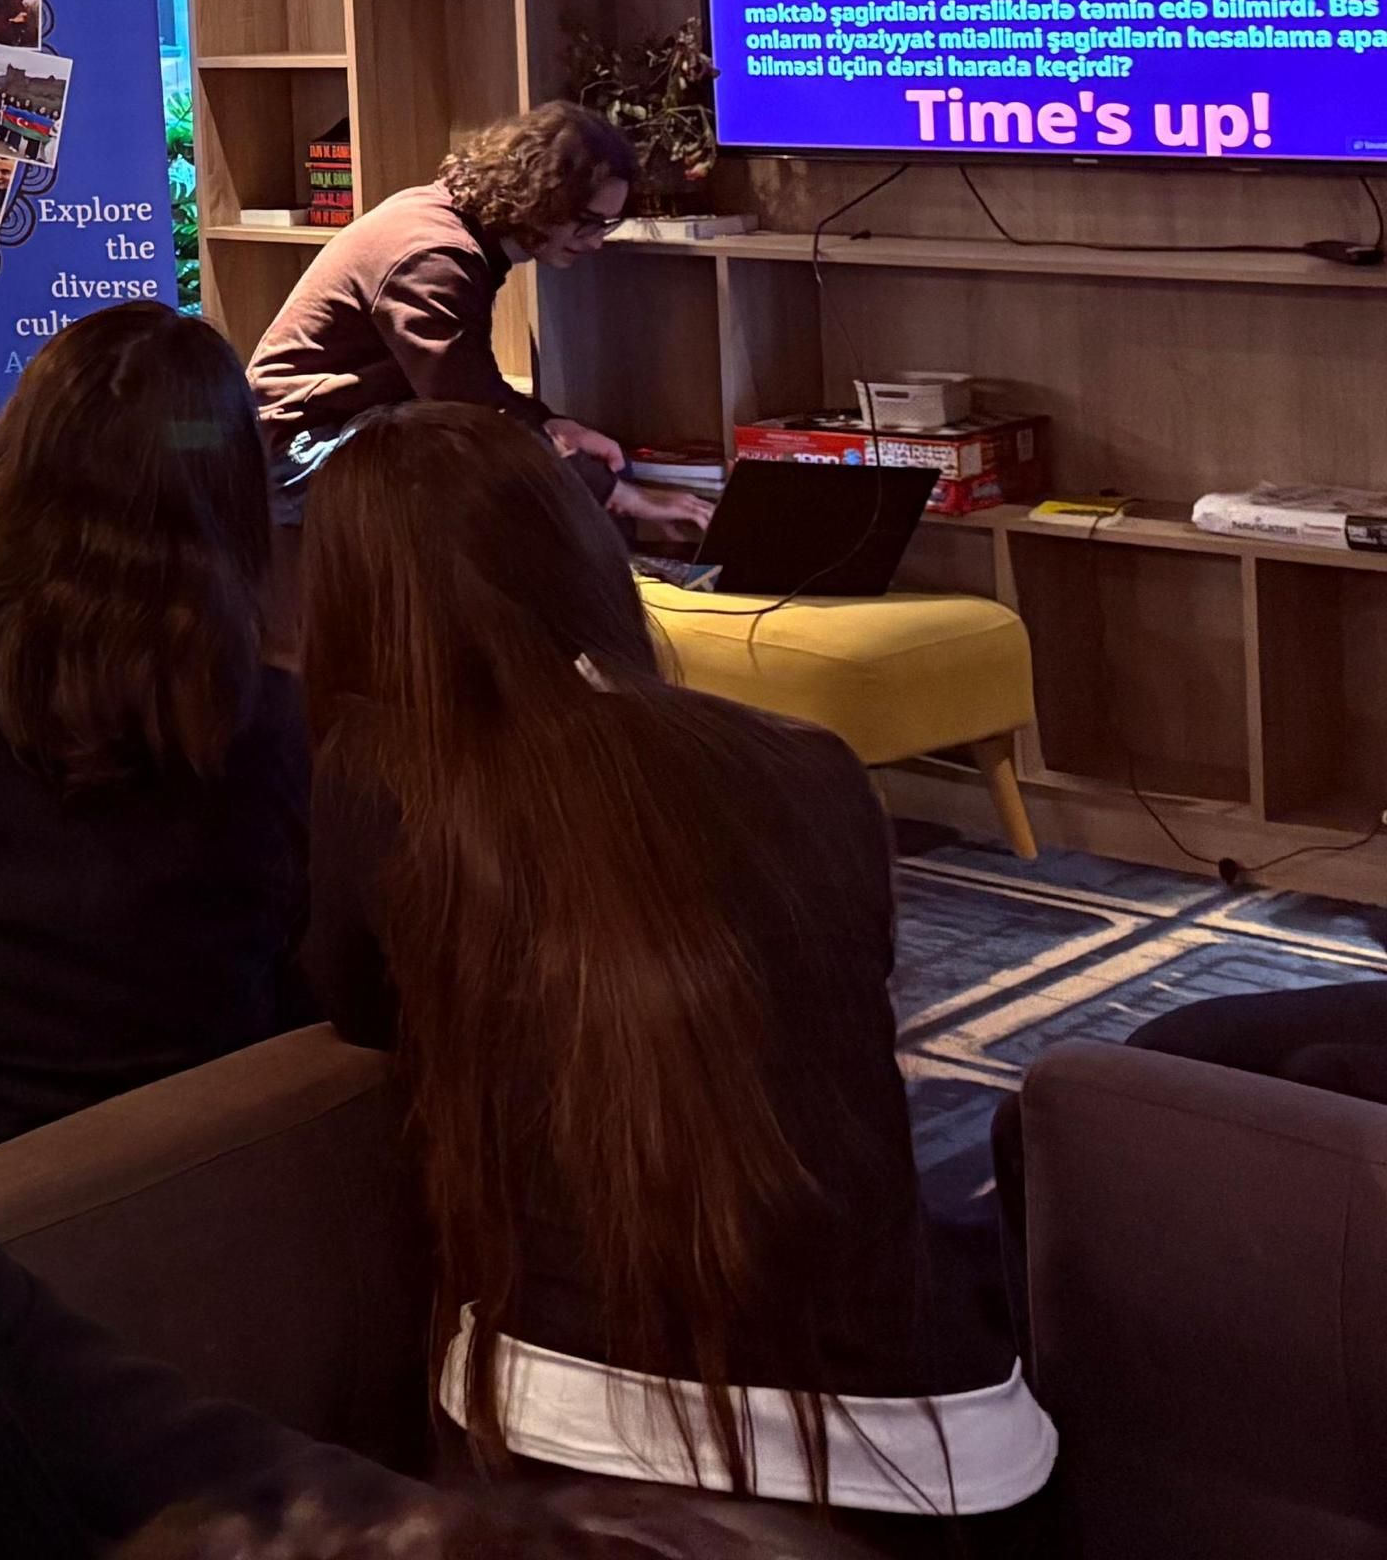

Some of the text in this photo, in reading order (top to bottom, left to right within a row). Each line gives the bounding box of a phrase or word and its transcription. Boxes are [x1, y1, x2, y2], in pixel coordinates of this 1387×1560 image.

[744, 2, 826, 24] məktəb
[830, 0, 936, 27] şagirdləri
[746, 24, 1387, 54] onların riyaziyyat müəllimi şagirdlərin hesablama apa
[747, 54, 1133, 83] bilməsi üçün dərsi harada keçirdi?
[905, 87, 1272, 157] Time's up!
[39, 196, 153, 228] Explore
[106, 234, 155, 261] the
[51, 272, 158, 300] diverse
[16, 310, 80, 337] cult
